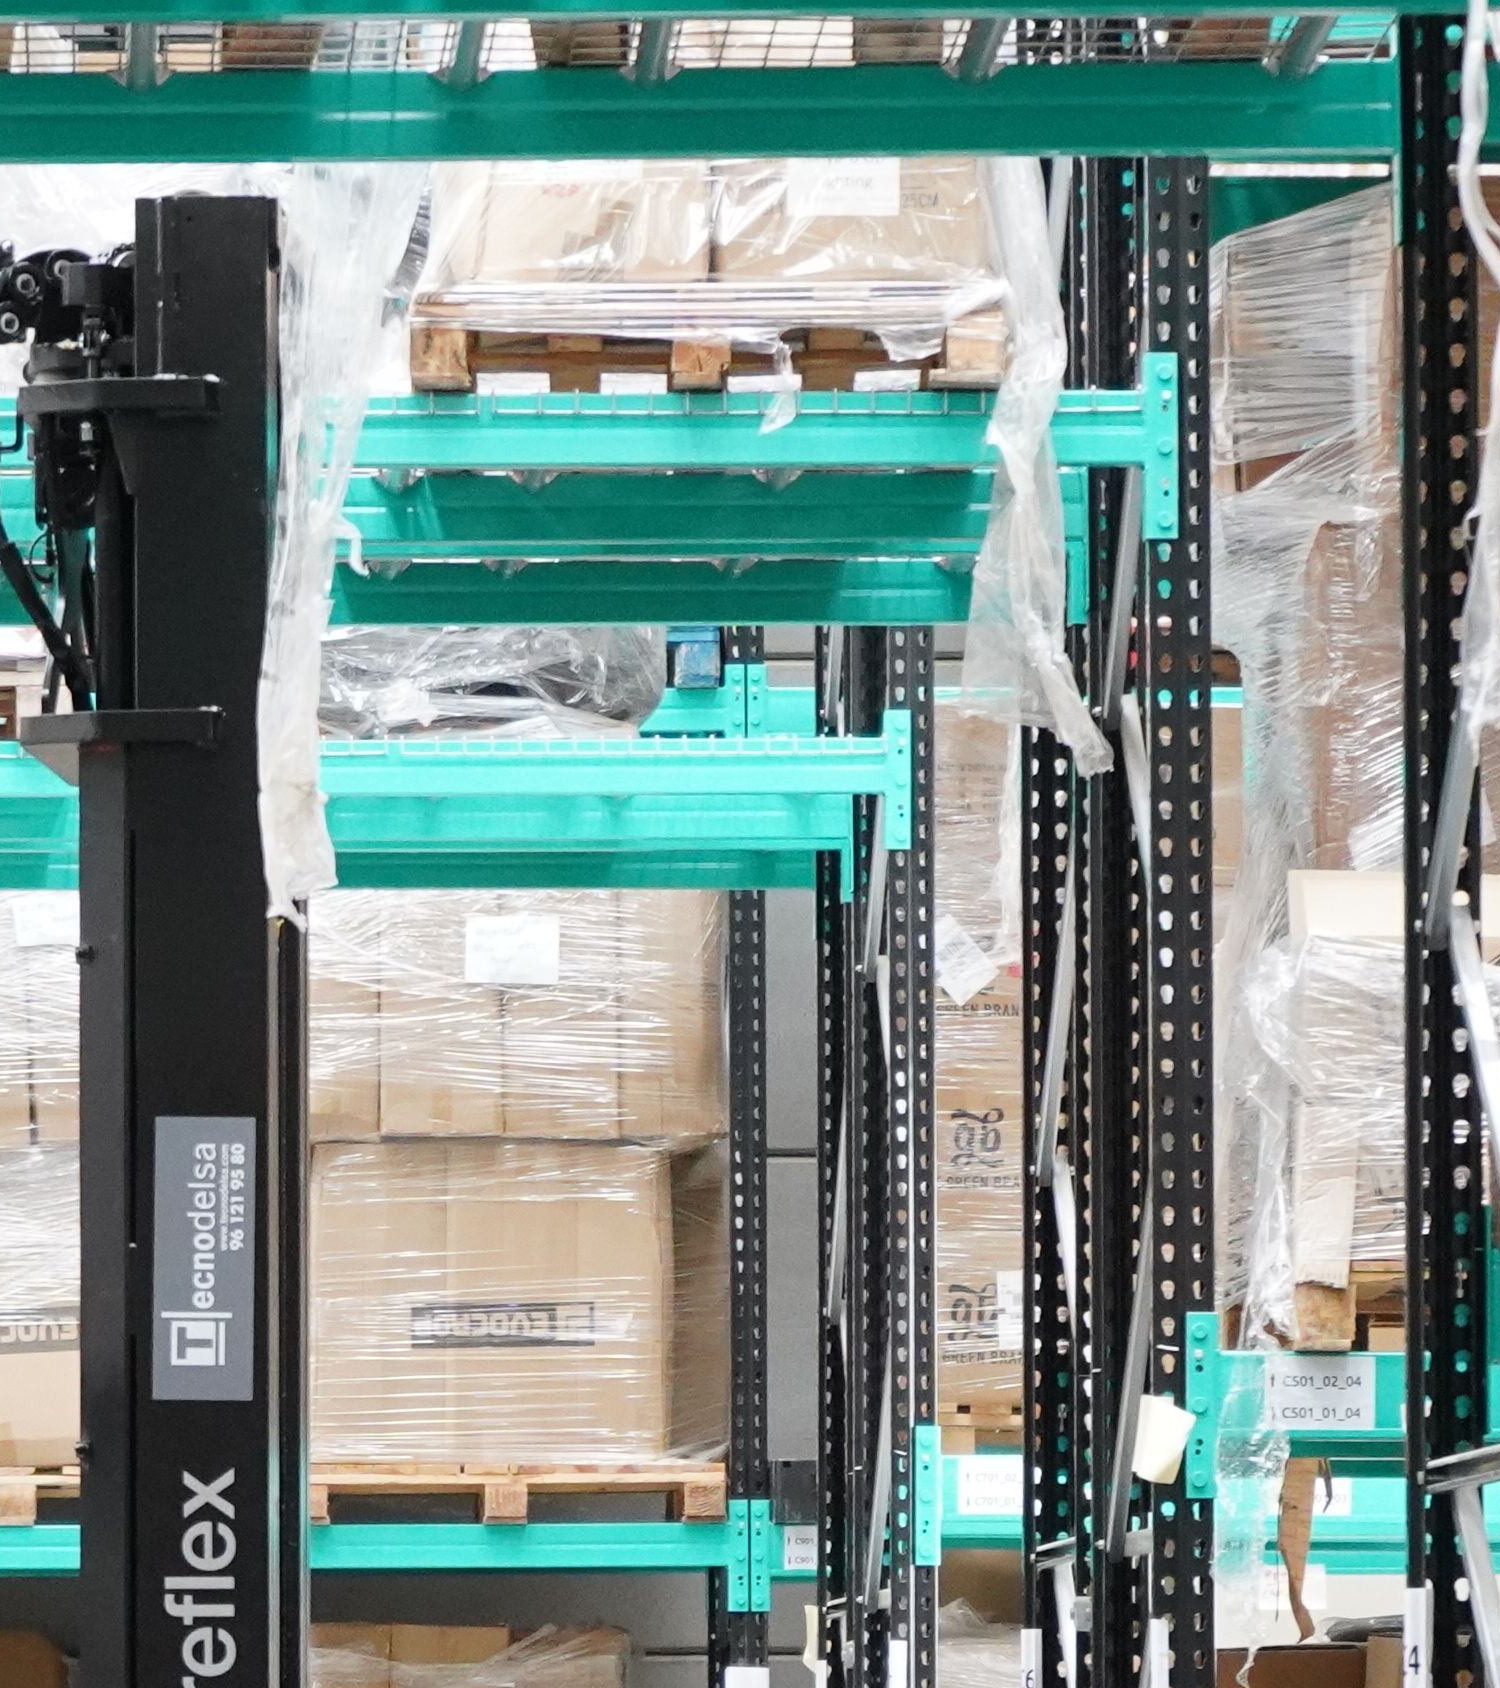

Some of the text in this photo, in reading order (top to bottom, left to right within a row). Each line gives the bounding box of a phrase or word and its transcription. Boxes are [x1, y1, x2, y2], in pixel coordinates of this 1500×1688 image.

[230, 1143, 245, 1251] 96 121 95 80
[1282, 1375, 1362, 1390] C501_02_04
[1281, 1407, 1361, 1421] C501_01_04
[1404, 1644, 1420, 1676] 4
